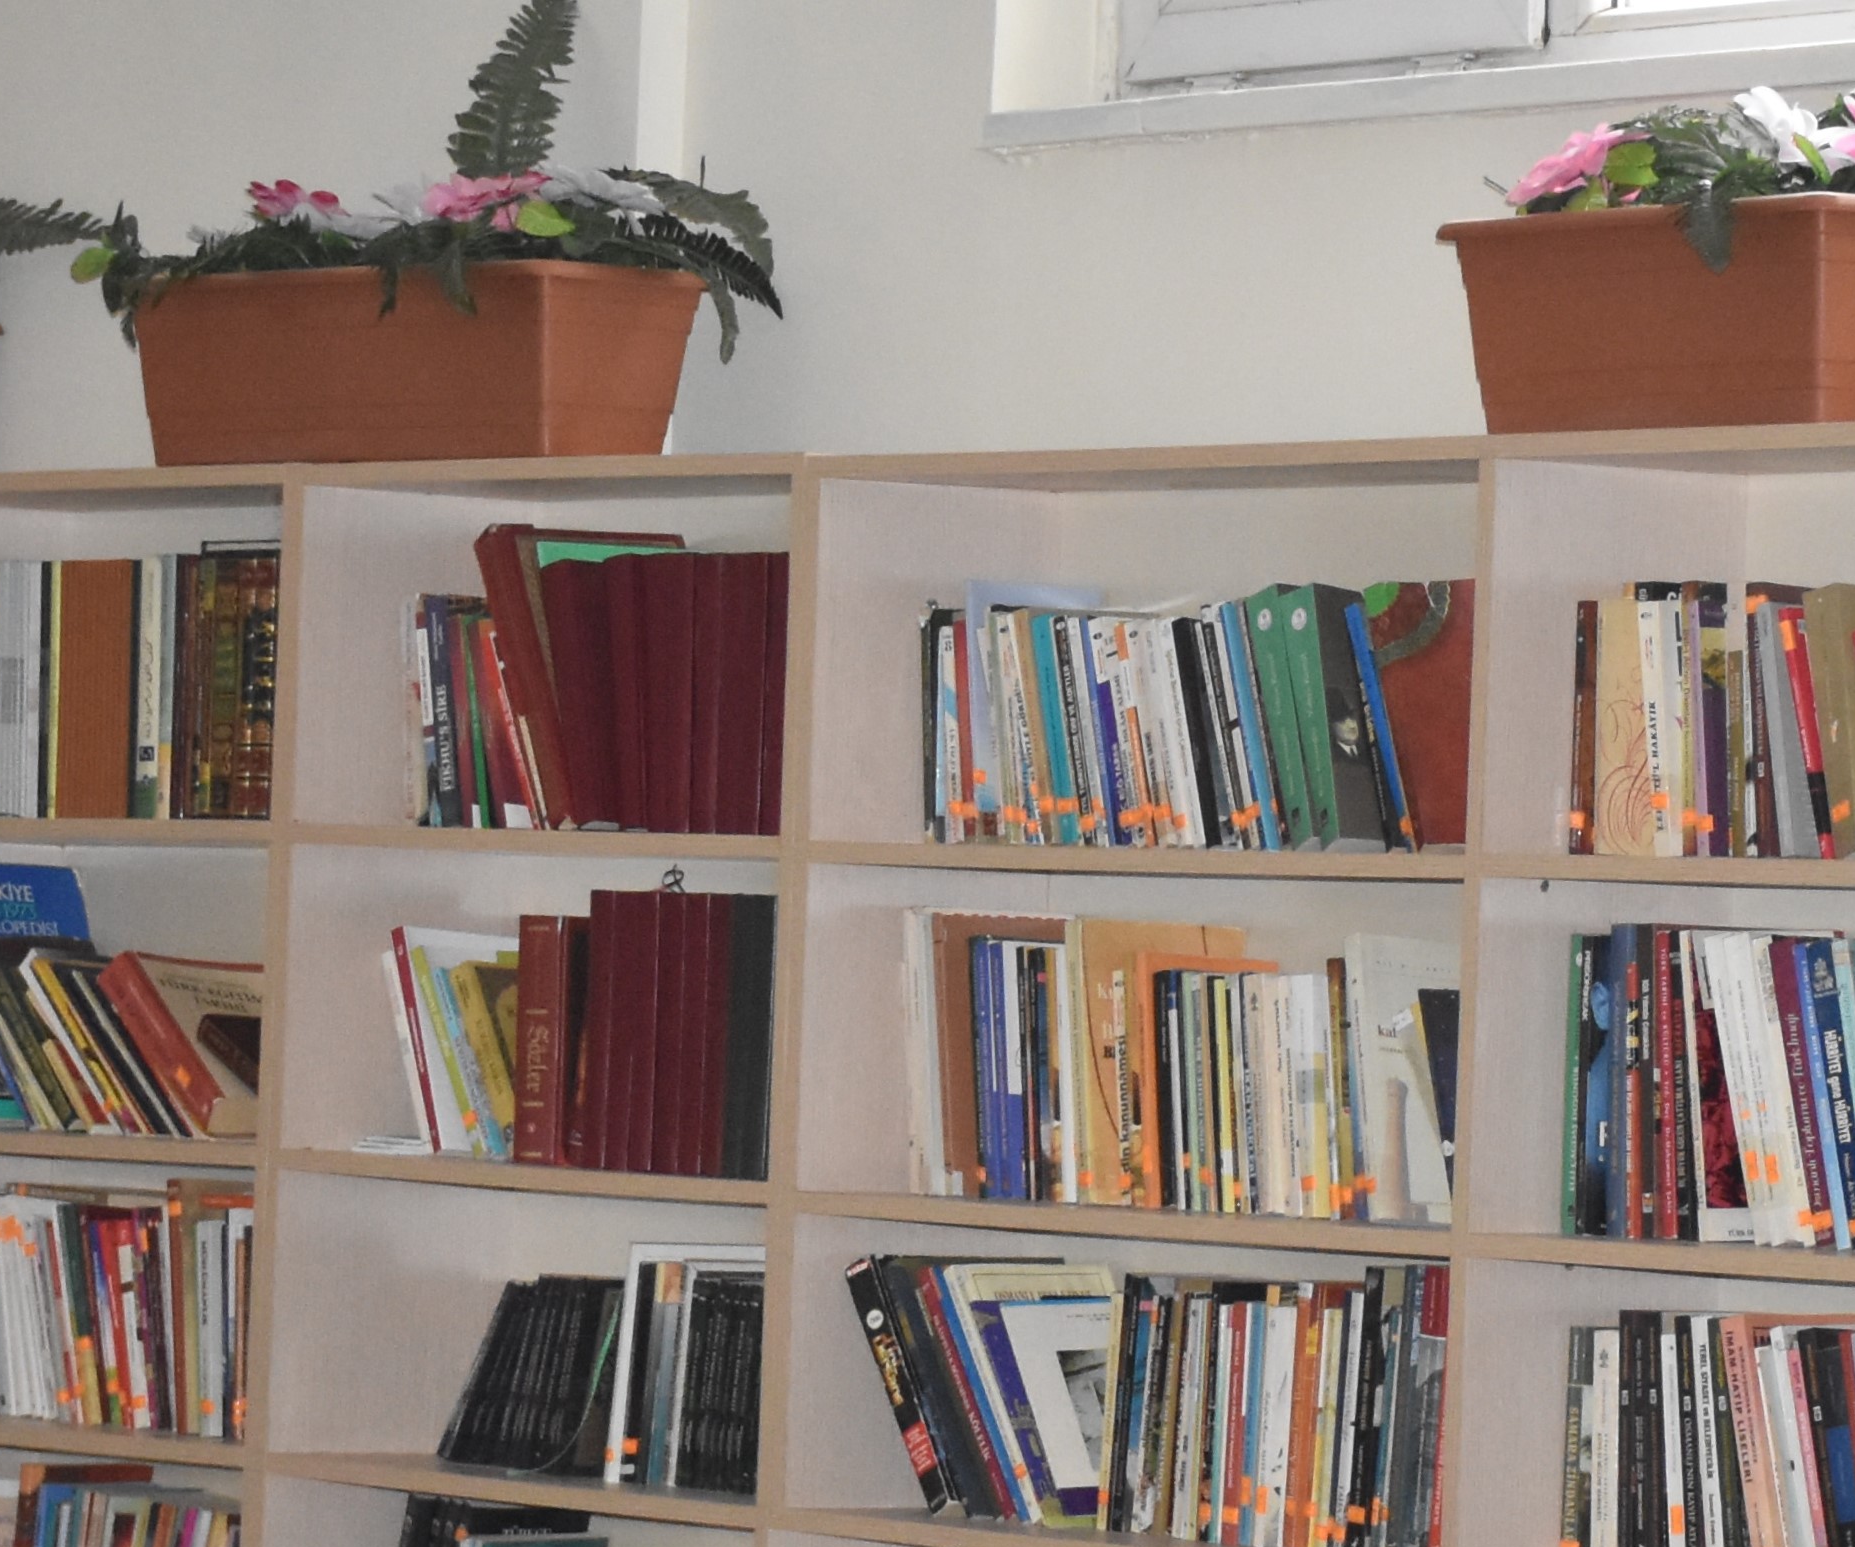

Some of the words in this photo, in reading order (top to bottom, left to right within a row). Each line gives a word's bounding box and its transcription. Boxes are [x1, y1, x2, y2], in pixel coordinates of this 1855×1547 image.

[1647, 701, 1658, 757] HAKÂYIK
[3, 903, 37, 918] 1973
[1659, 948, 1667, 971] TÜRK
[1659, 976, 1668, 1006] TARİHİ
[527, 1025, 547, 1092] Sözler
[1661, 1024, 1669, 1065] KÜLTÜRÜ
[1823, 1029, 1844, 1074] HÜRRİYET
[1674, 1059, 1684, 1084] ALANI
[1789, 1048, 1804, 1077] Türk
[1116, 1034, 1128, 1142] kanunnamesi
[1829, 1075, 1843, 1098] gene
[1833, 1099, 1854, 1143] HÜRRİYET
[1698, 1343, 1708, 1369] YEREL
[1699, 1371, 1710, 1404] SİYASET
[1724, 1330, 1745, 1414] İMAM-HATİP
[1736, 1419, 1754, 1482] LİSELERİ
[1683, 1417, 1695, 1489] OSMANLI'NIN
[1686, 1492, 1696, 1522] KAYIP
